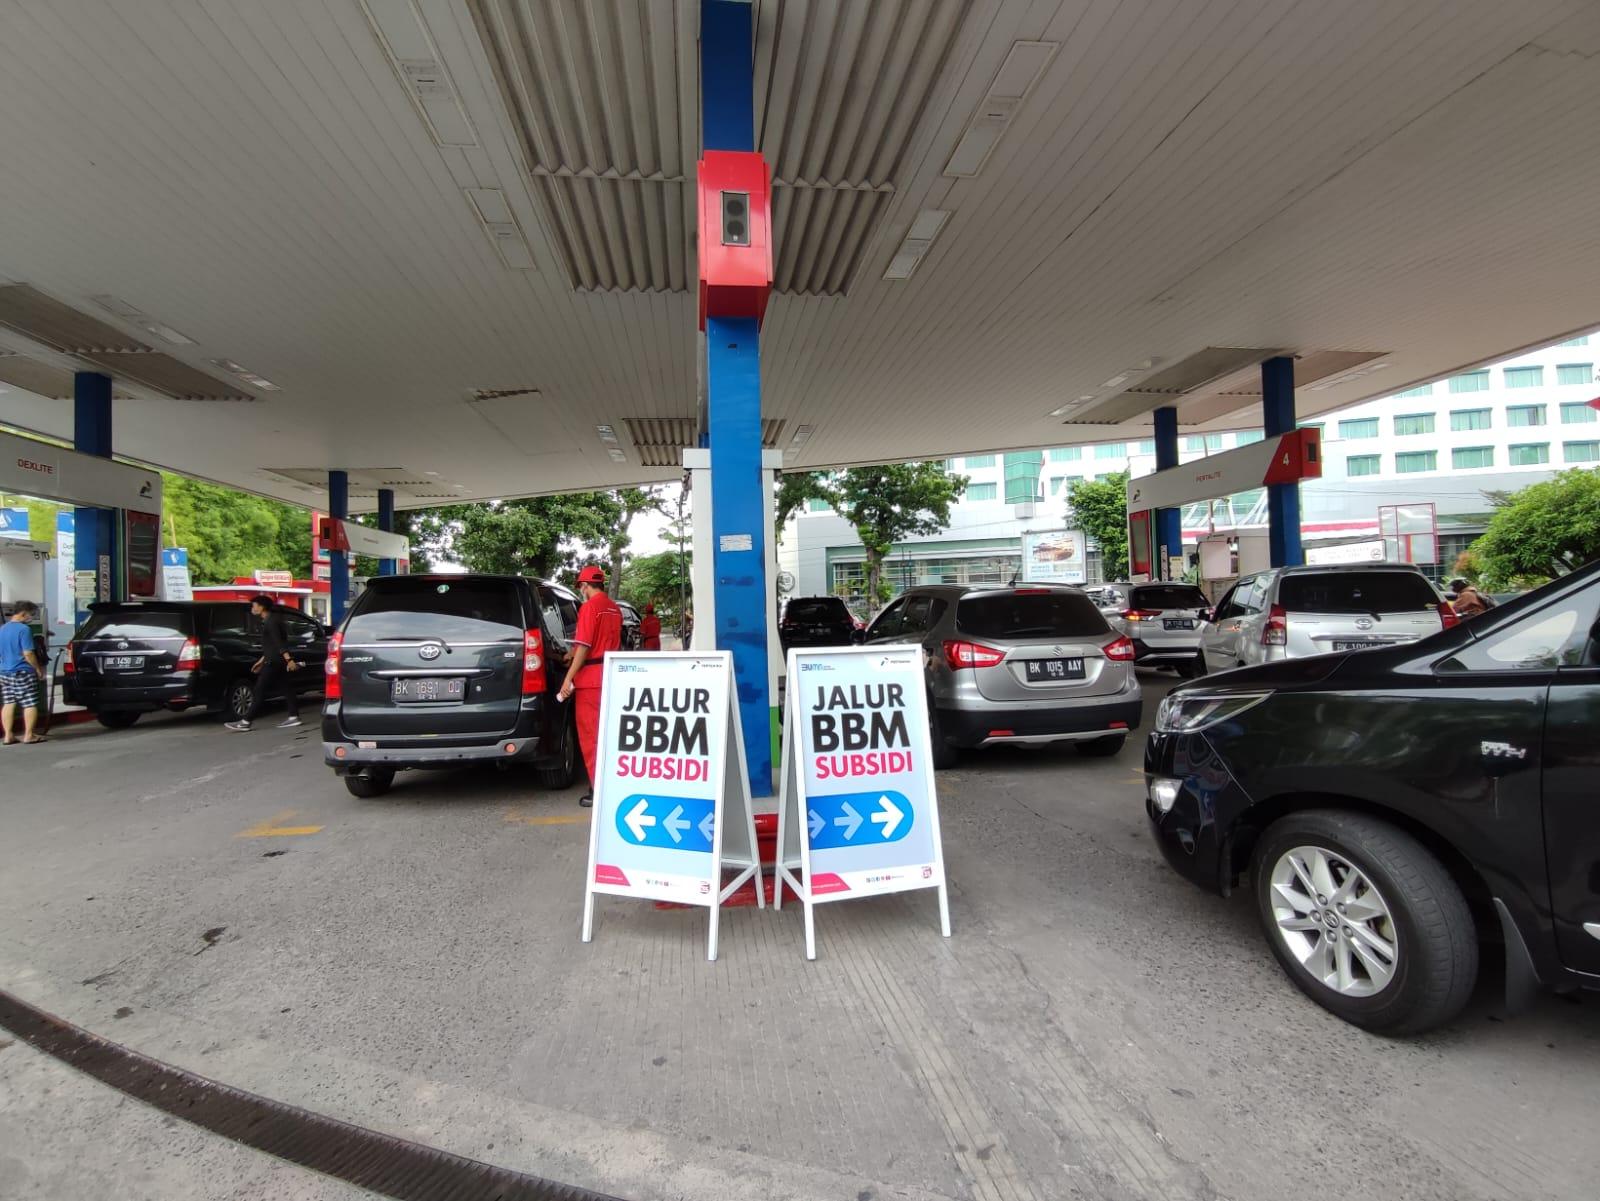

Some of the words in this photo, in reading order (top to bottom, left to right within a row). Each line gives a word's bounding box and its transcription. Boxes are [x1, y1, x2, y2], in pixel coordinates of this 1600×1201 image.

[17, 458, 54, 474] DEXLITE
[1282, 452, 1290, 466] 4
[1029, 662, 1040, 673] BK
[1046, 661, 1063, 672] 1015
[1067, 660, 1082, 671] AAY
[395, 681, 408, 695] BK
[416, 681, 439, 694] 1691
[622, 687, 710, 714] JALUR
[812, 683, 906, 711] JALUR
[618, 714, 709, 756] BBM
[811, 710, 911, 753] BBM
[616, 755, 708, 782] SUBSIDI
[815, 751, 913, 779] SUBSIDI
